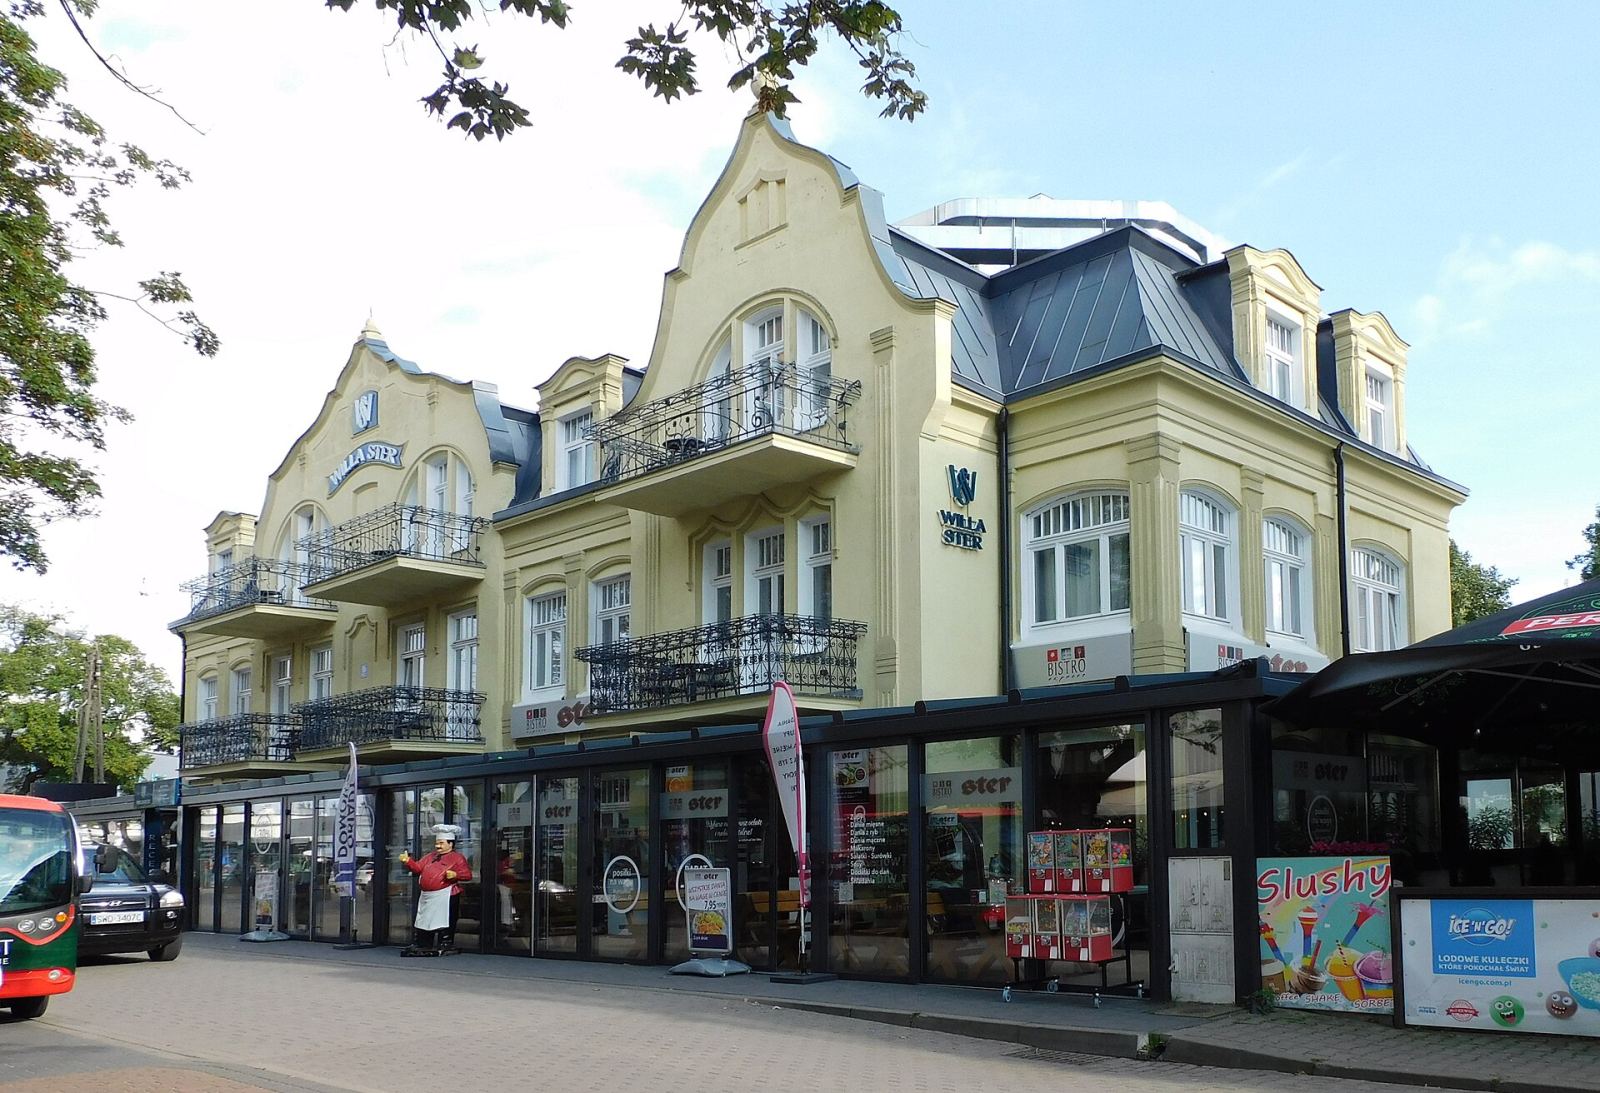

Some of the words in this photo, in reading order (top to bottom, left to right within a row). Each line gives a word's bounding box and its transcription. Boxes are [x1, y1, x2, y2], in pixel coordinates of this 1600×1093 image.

[329, 448, 365, 485] WILLA
[366, 444, 397, 464] STER
[937, 509, 987, 533] WILLA
[942, 529, 983, 550] STER
[1047, 659, 1086, 677] BISTRO
[1269, 653, 1309, 673] ter
[526, 717, 547, 731] BISTRO
[962, 776, 1012, 795] ster
[545, 804, 572, 819] ster
[688, 796, 723, 811] ster
[869, 828, 879, 837] ryb
[1257, 859, 1391, 904] Slushy
[1438, 954, 1479, 963] LODOWE
[1481, 956, 1529, 965] KULECZKI
[1463, 964, 1504, 972] POKOCHAŁ
[1505, 964, 1530, 973] ŚWIAT
[1458, 977, 1512, 988] icengo.com.pl
[1275, 992, 1300, 1001] offee
[1305, 992, 1342, 1004] SHAKE
[1353, 998, 1393, 1009] SORBE
